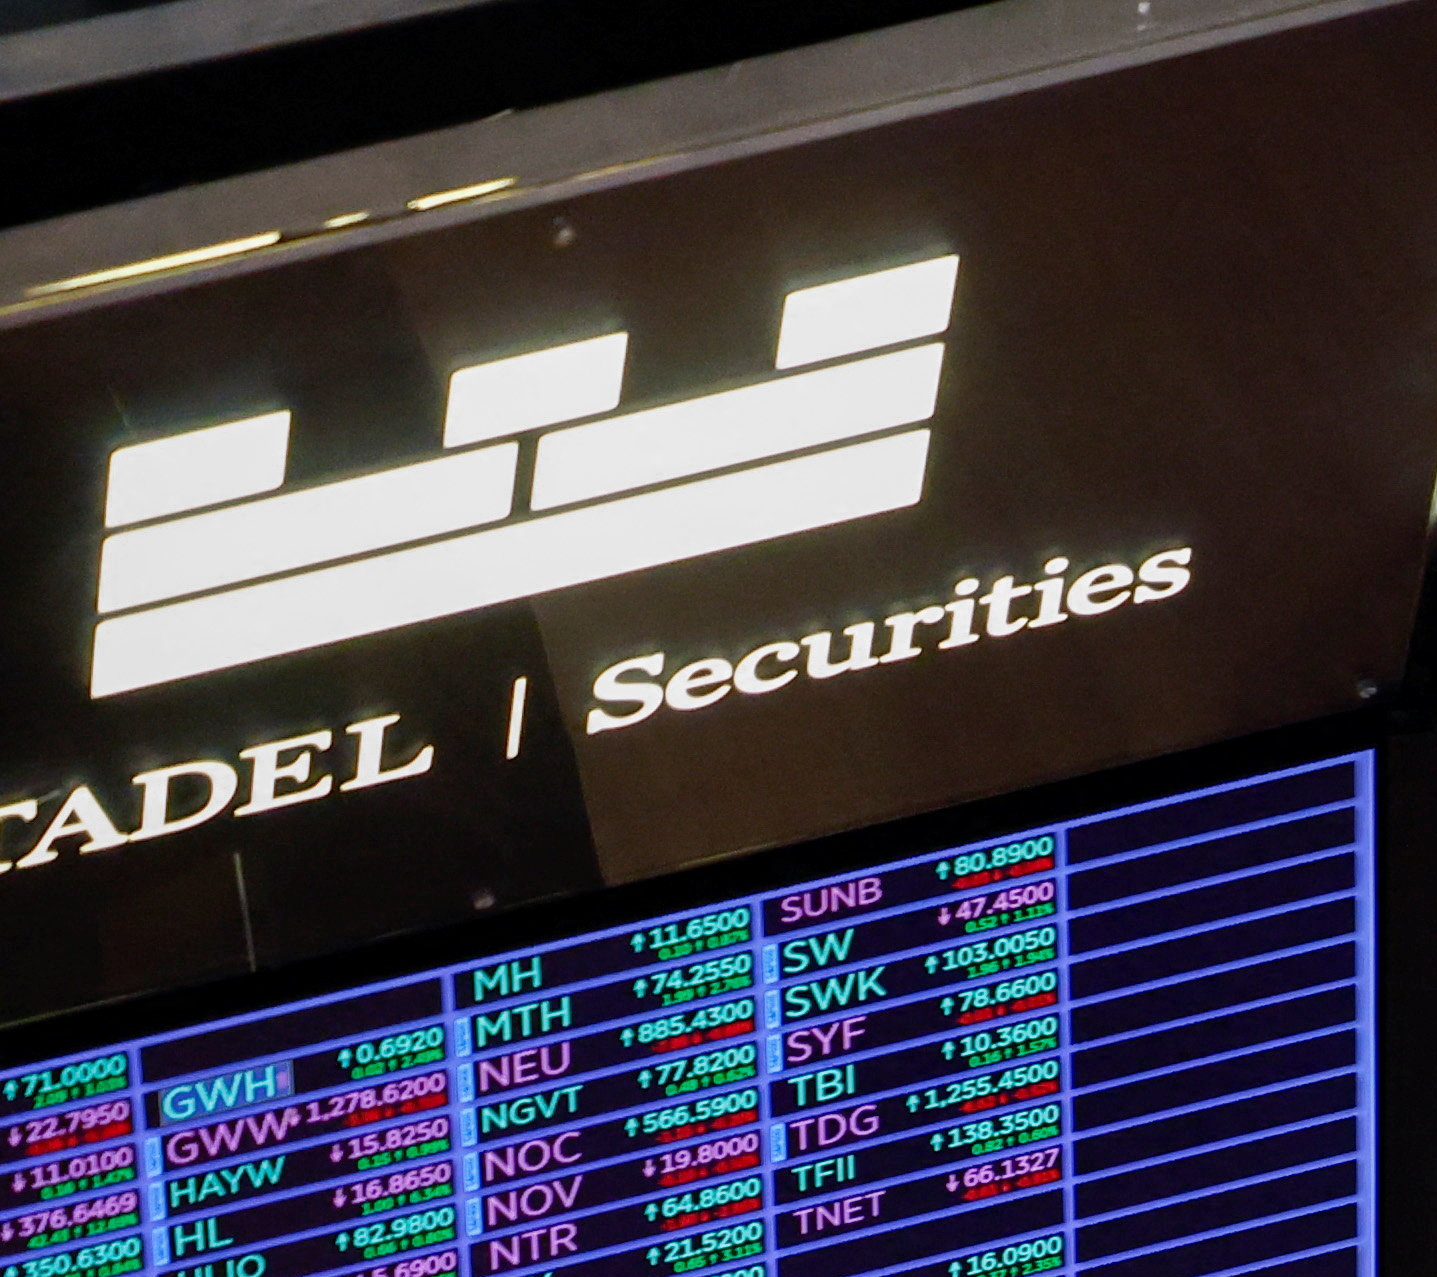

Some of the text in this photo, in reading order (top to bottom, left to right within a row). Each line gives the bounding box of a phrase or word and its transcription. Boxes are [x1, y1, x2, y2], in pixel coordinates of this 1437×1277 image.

[587, 544, 1193, 734] Securities
[781, 877, 883, 923] SUNB
[954, 836, 1054, 876] 80.8900
[783, 882, 1054, 973] SW 47.4500
